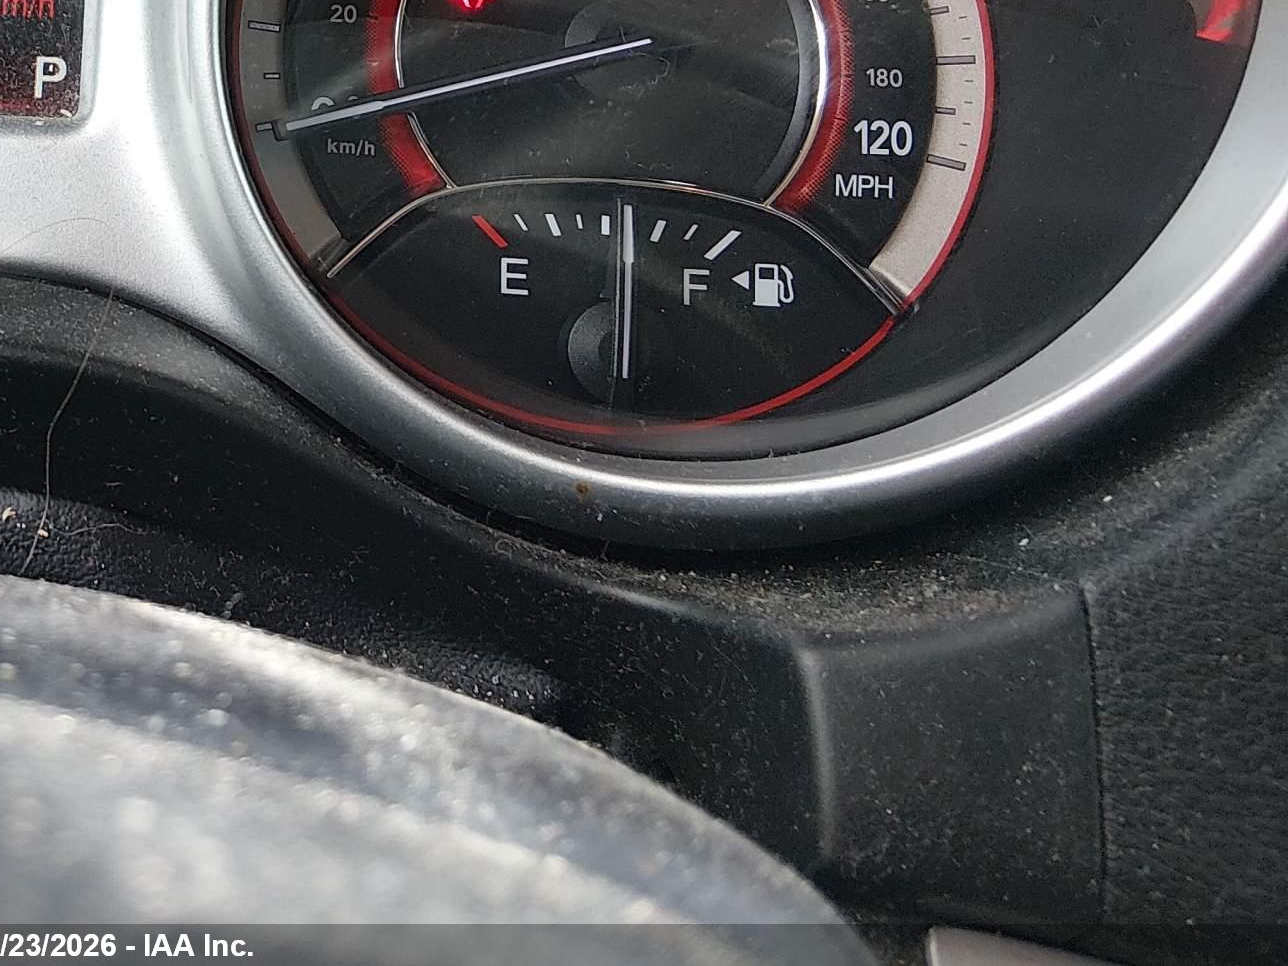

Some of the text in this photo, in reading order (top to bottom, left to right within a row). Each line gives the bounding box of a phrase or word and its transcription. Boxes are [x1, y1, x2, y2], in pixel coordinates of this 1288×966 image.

[330, 5, 357, 24] 20
[34, 56, 66, 99] P
[867, 69, 903, 88] 180
[327, 138, 375, 158] km/h
[855, 120, 912, 156] 120
[835, 175, 894, 199] MPH
[500, 257, 528, 295] E
[683, 269, 710, 306] F
